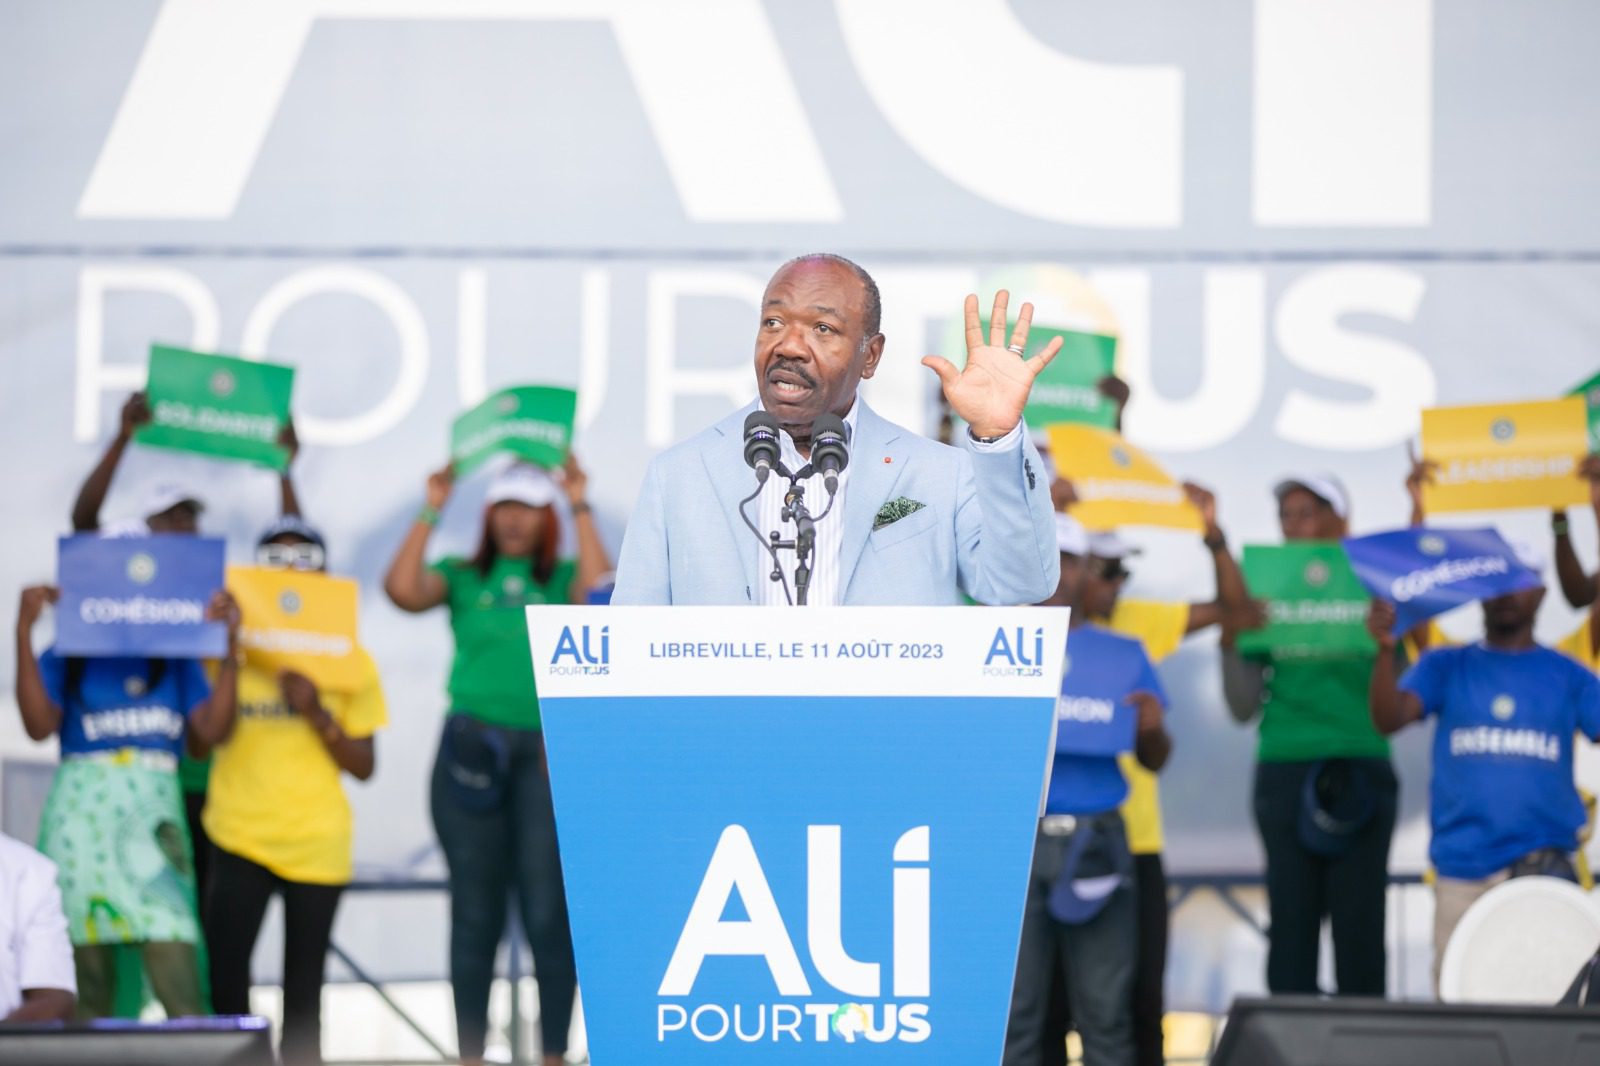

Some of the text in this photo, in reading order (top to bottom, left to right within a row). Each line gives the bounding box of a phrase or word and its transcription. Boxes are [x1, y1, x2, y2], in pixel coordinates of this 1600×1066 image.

[1391, 556, 1509, 602] COHÉSION
[80, 595, 203, 624] COHÉSION
[650, 639, 944, 660] LIBREVILLE, LE 11 AOÛT 2023
